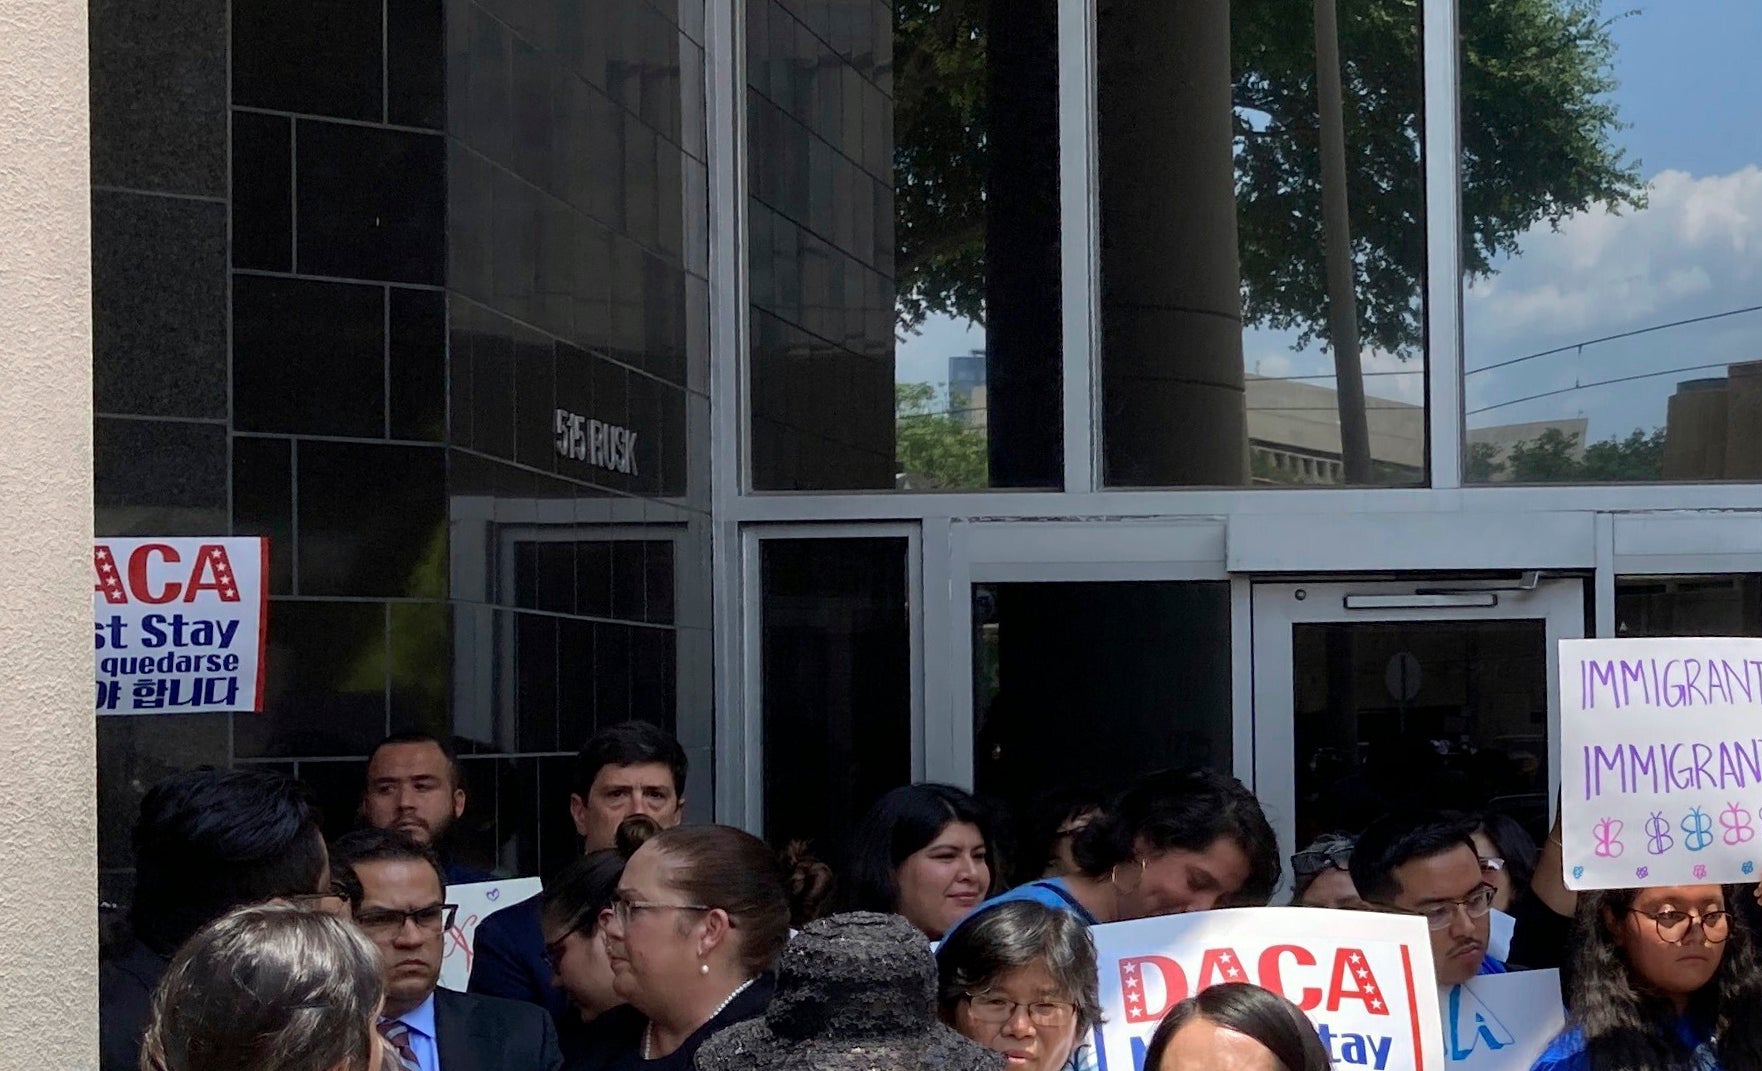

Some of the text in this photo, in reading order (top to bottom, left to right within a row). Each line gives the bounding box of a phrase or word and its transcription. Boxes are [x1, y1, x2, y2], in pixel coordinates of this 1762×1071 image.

[556, 408, 638, 476] 515 RUSK
[141, 614, 240, 649] Stay
[101, 651, 240, 678] quedarse
[133, 676, 240, 709] 합니다
[1118, 944, 1390, 1024] DACA
[1318, 1023, 1393, 1071] tay
